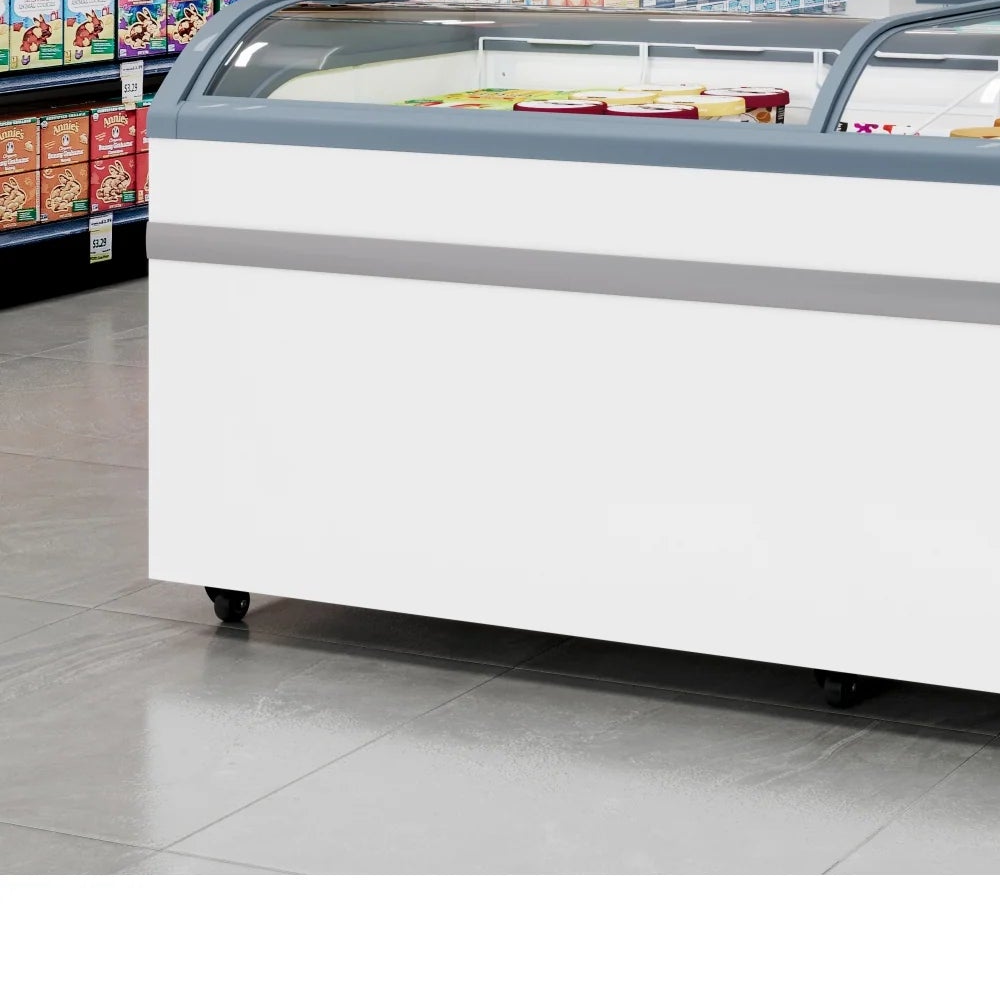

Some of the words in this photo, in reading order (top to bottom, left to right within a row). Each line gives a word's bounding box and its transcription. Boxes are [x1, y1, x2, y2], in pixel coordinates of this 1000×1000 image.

[124, 83, 138, 93] $3.29
[103, 113, 128, 125] Annie's
[53, 121, 79, 135] Annie's
[92, 238, 107, 248] $3.29
